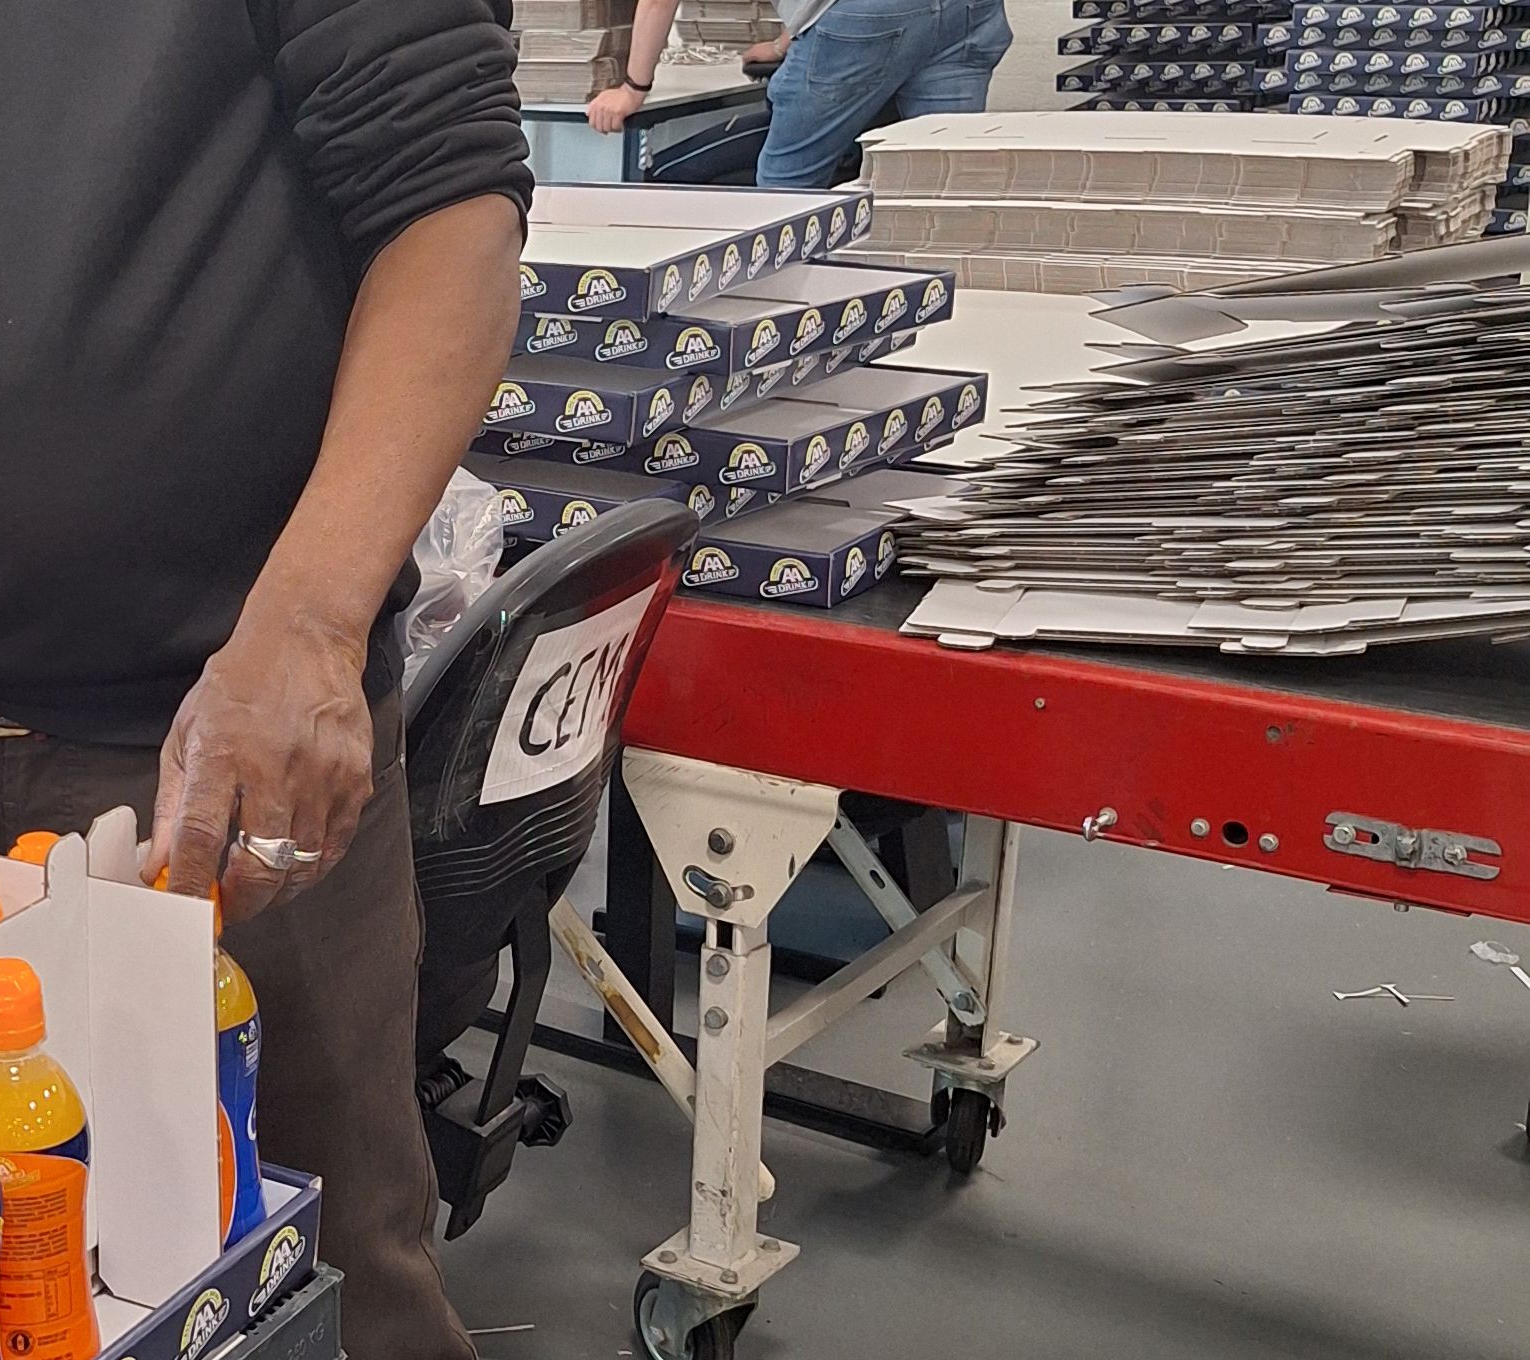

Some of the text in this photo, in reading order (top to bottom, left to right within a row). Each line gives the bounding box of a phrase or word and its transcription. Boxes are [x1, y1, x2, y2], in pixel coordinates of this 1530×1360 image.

[590, 278, 608, 295] AA
[585, 292, 615, 306] DRINK
[546, 321, 563, 337] AA
[616, 329, 634, 345] AA
[611, 343, 638, 357] DRINK
[686, 337, 705, 354] AA
[683, 351, 711, 364] DRINK
[502, 393, 521, 408] AA
[498, 405, 526, 417] DRINK
[577, 401, 597, 416] AA
[573, 414, 602, 427] DRINK
[665, 442, 685, 458] AA
[661, 455, 689, 469] DRINK
[740, 452, 761, 469] AA
[737, 466, 766, 478] DRINK
[503, 499, 520, 513] AA
[704, 557, 724, 572] AA
[700, 570, 730, 582] DRINK
[782, 567, 803, 583] AA
[778, 582, 808, 593] DRINK
[271, 1239, 292, 1274] AA
[193, 1302, 214, 1343] AA
